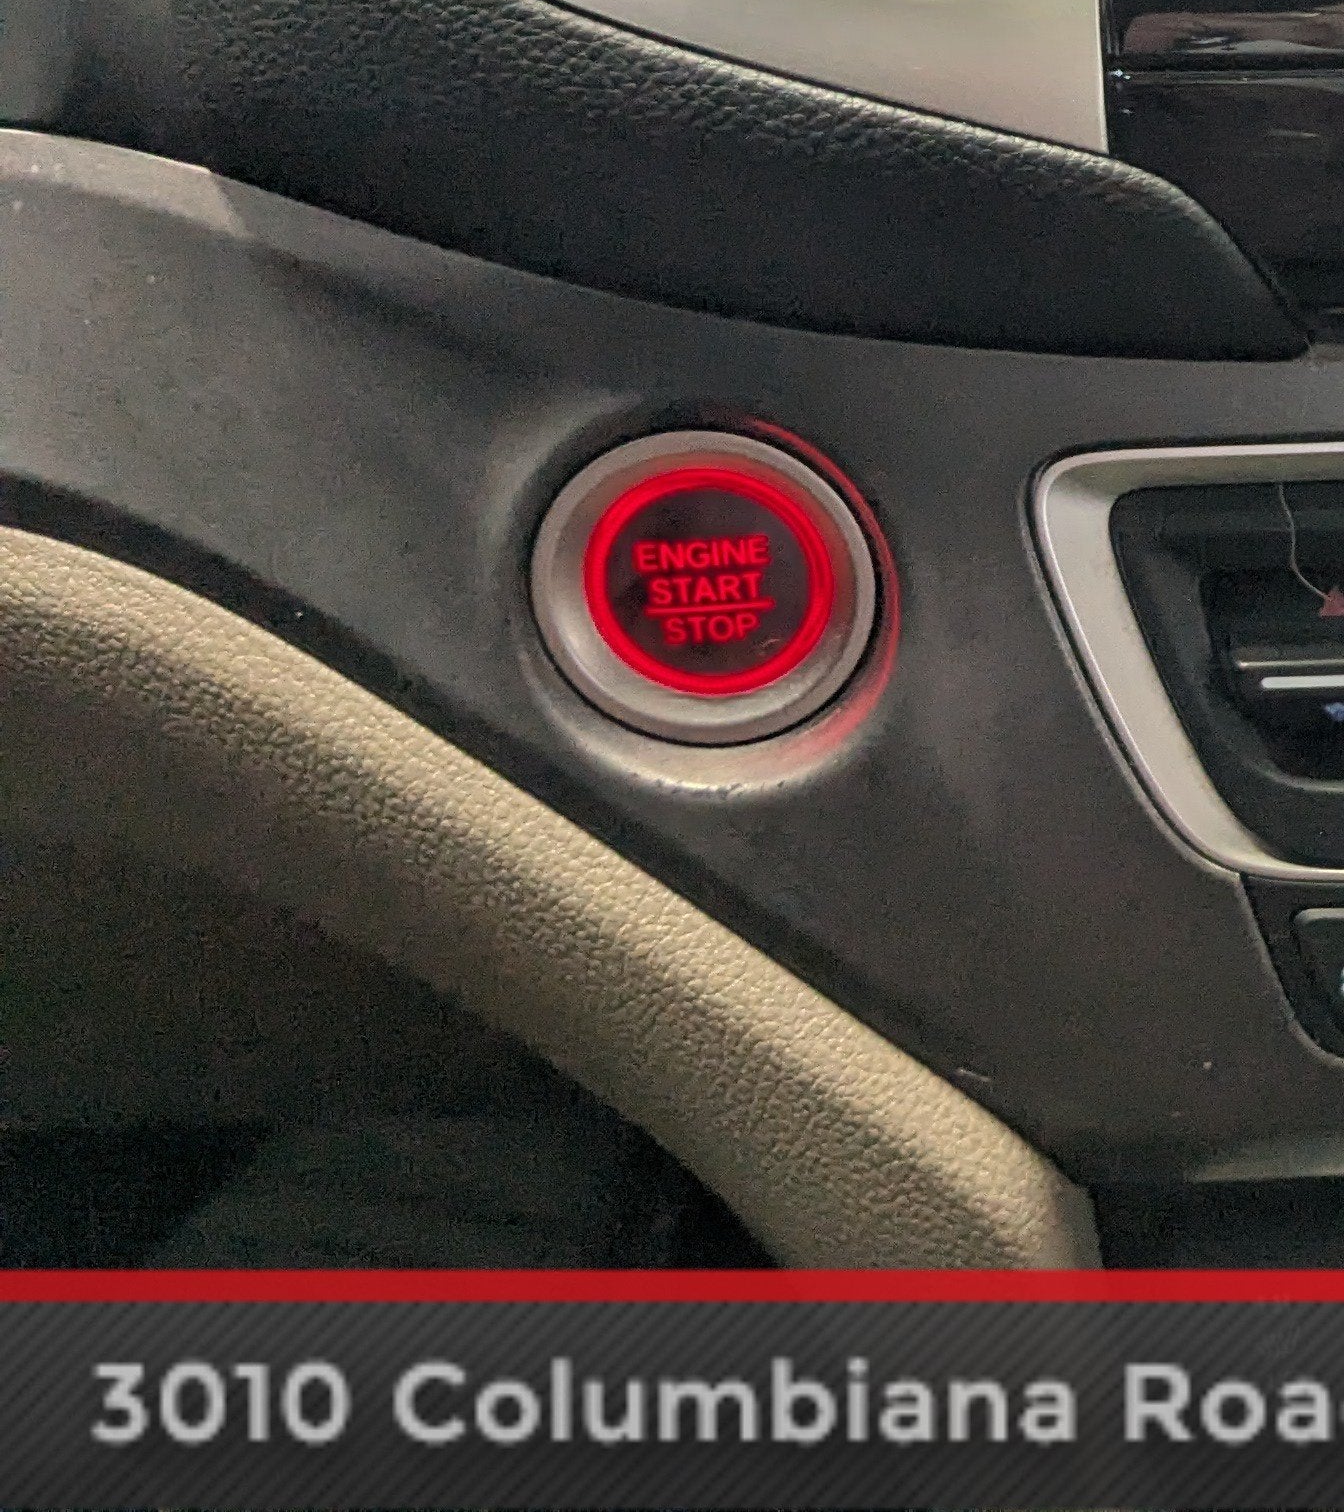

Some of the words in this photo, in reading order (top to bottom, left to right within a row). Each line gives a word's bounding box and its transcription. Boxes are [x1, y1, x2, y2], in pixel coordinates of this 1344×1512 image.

[634, 535, 770, 572] ENGINE
[651, 573, 763, 604] START
[664, 613, 760, 645] STOP
